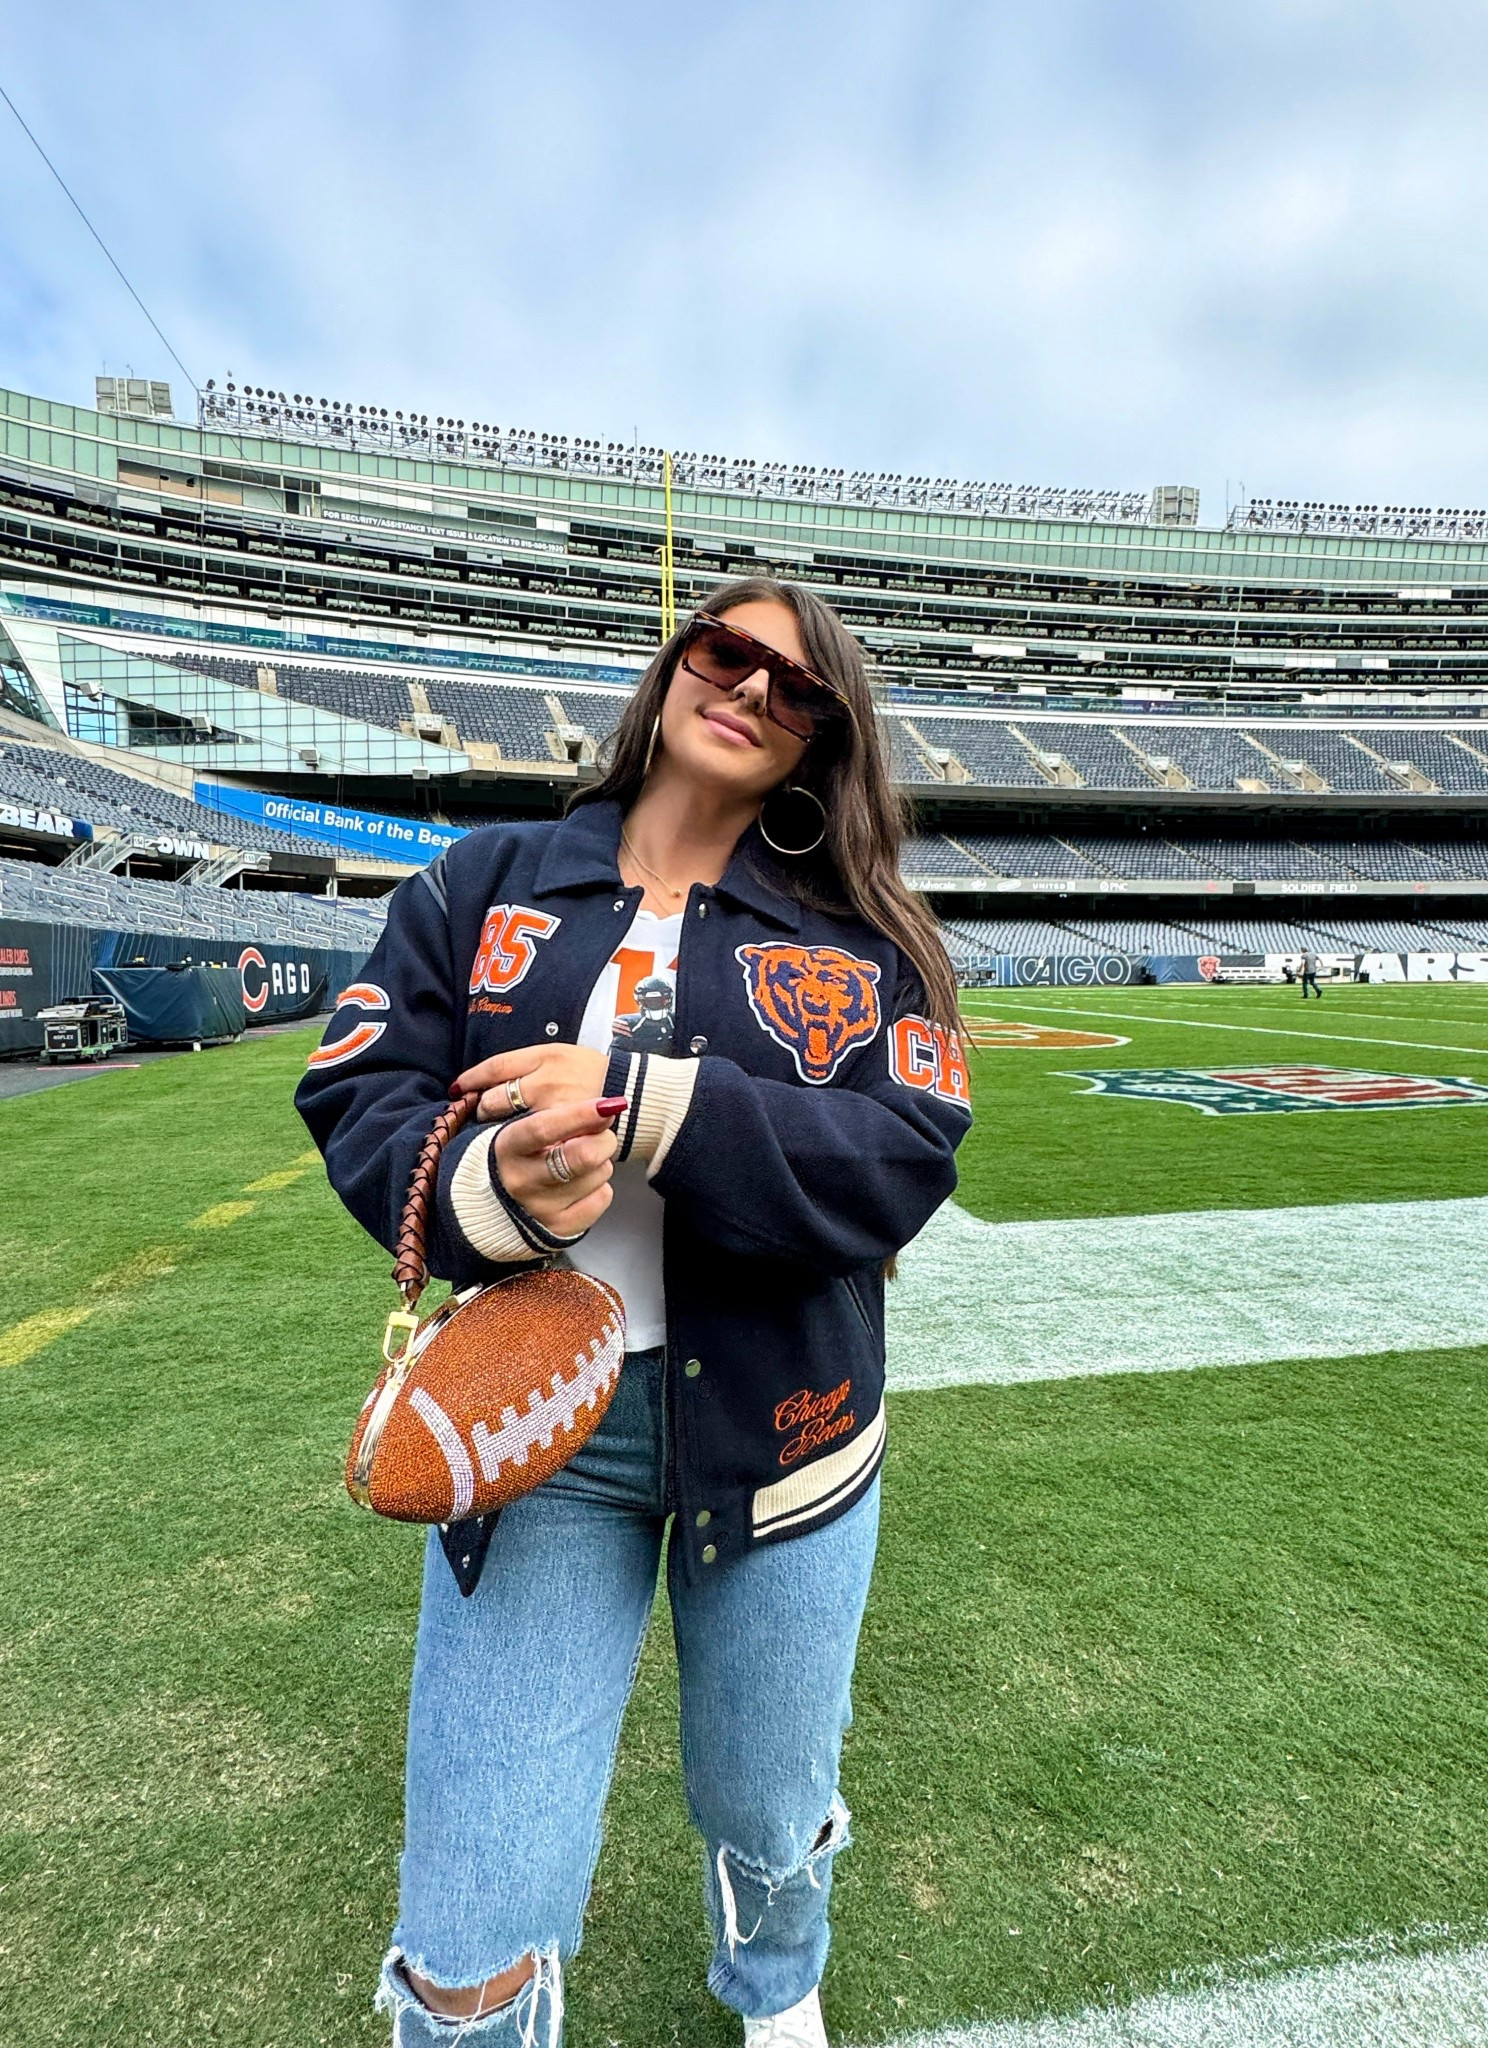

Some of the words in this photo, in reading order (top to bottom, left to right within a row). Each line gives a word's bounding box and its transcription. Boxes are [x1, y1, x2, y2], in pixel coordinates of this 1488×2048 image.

[323, 510, 341, 520] FOR
[427, 526, 446, 535] TEXT
[446, 529, 467, 539] ISSUE
[474, 533, 510, 545] LOCATION
[510, 539, 520, 547] TO
[0, 803, 75, 838] BEAR
[265, 801, 320, 824] Official
[324, 810, 364, 832] Bank
[367, 820, 384, 836] of
[387, 822, 414, 841] the
[156, 836, 210, 860] OWN
[918, 879, 957, 890] Advocate
[1110, 882, 1128, 891] PNC
[1281, 883, 1325, 893] SOLDIER
[1329, 883, 1358, 893] FIELD
[469, 903, 562, 994] 85
[774, 1379, 851, 1431] Chicago
[779, 1409, 856, 1466] Bears
